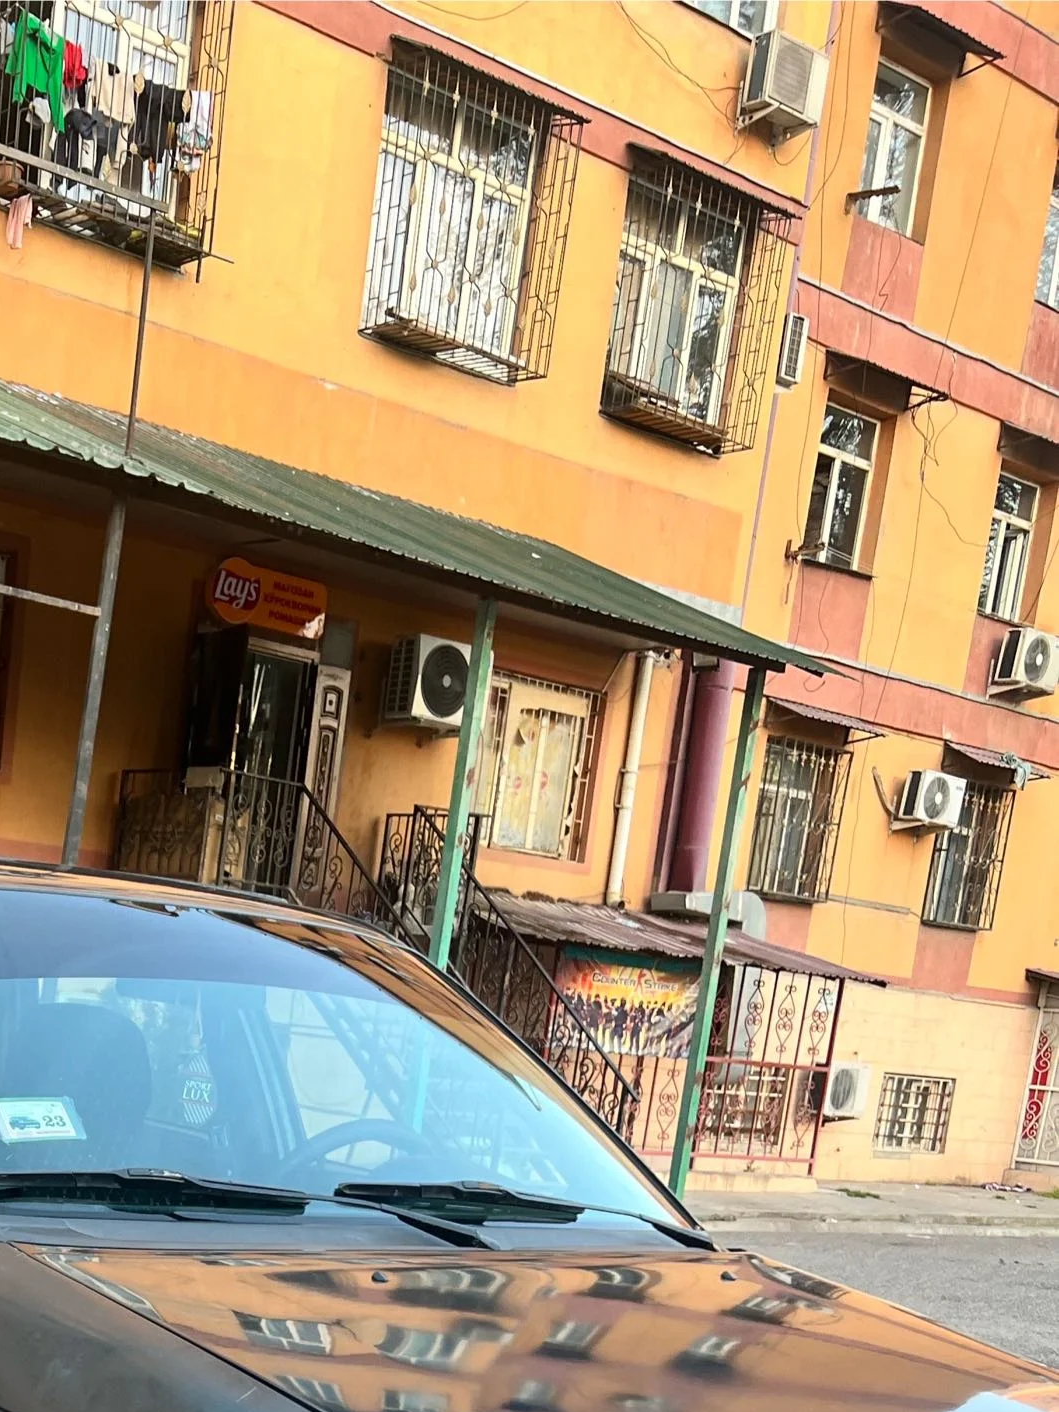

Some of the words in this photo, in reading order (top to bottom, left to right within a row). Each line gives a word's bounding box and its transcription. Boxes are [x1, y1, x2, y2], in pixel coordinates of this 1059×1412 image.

[214, 570, 260, 608] Lay's
[184, 1080, 211, 1091] SPORT
[183, 1088, 210, 1103] LUX
[43, 1115, 66, 1127] 23
